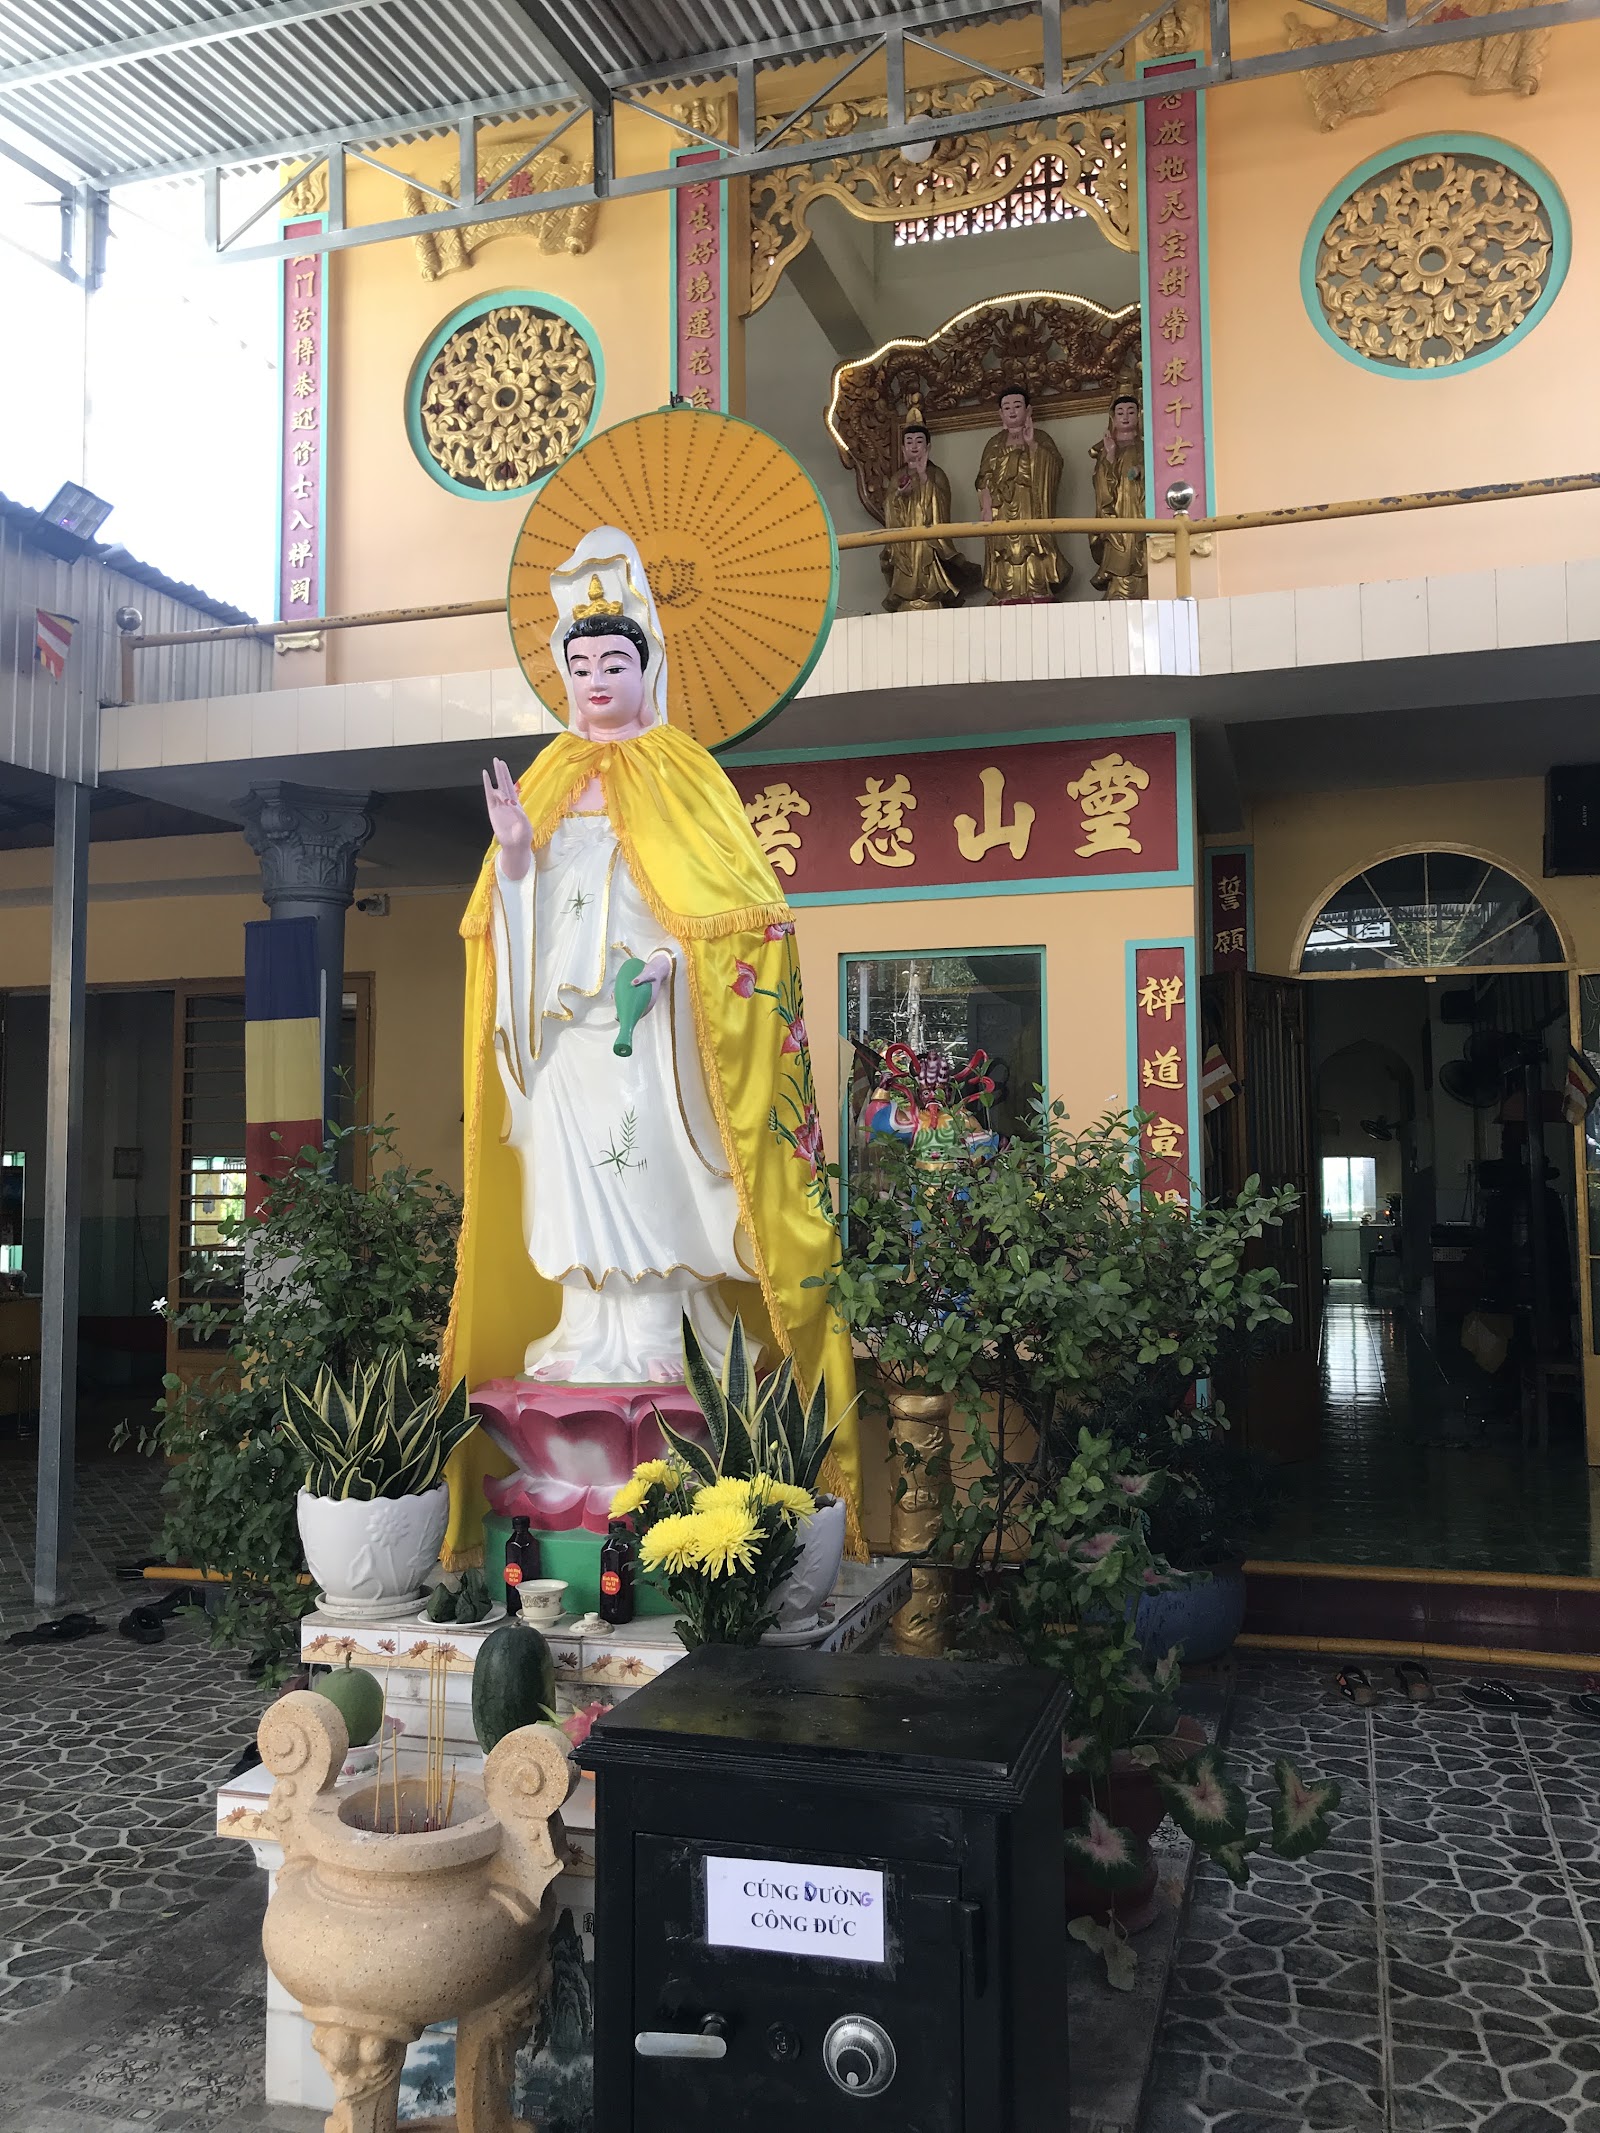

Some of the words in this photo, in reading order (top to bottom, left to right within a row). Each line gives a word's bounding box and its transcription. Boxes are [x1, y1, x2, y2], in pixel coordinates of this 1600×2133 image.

[743, 1878, 798, 1901] CÚNG
[751, 1909, 808, 1932] CÔNG
[813, 1915, 857, 1937] ĐỨC
